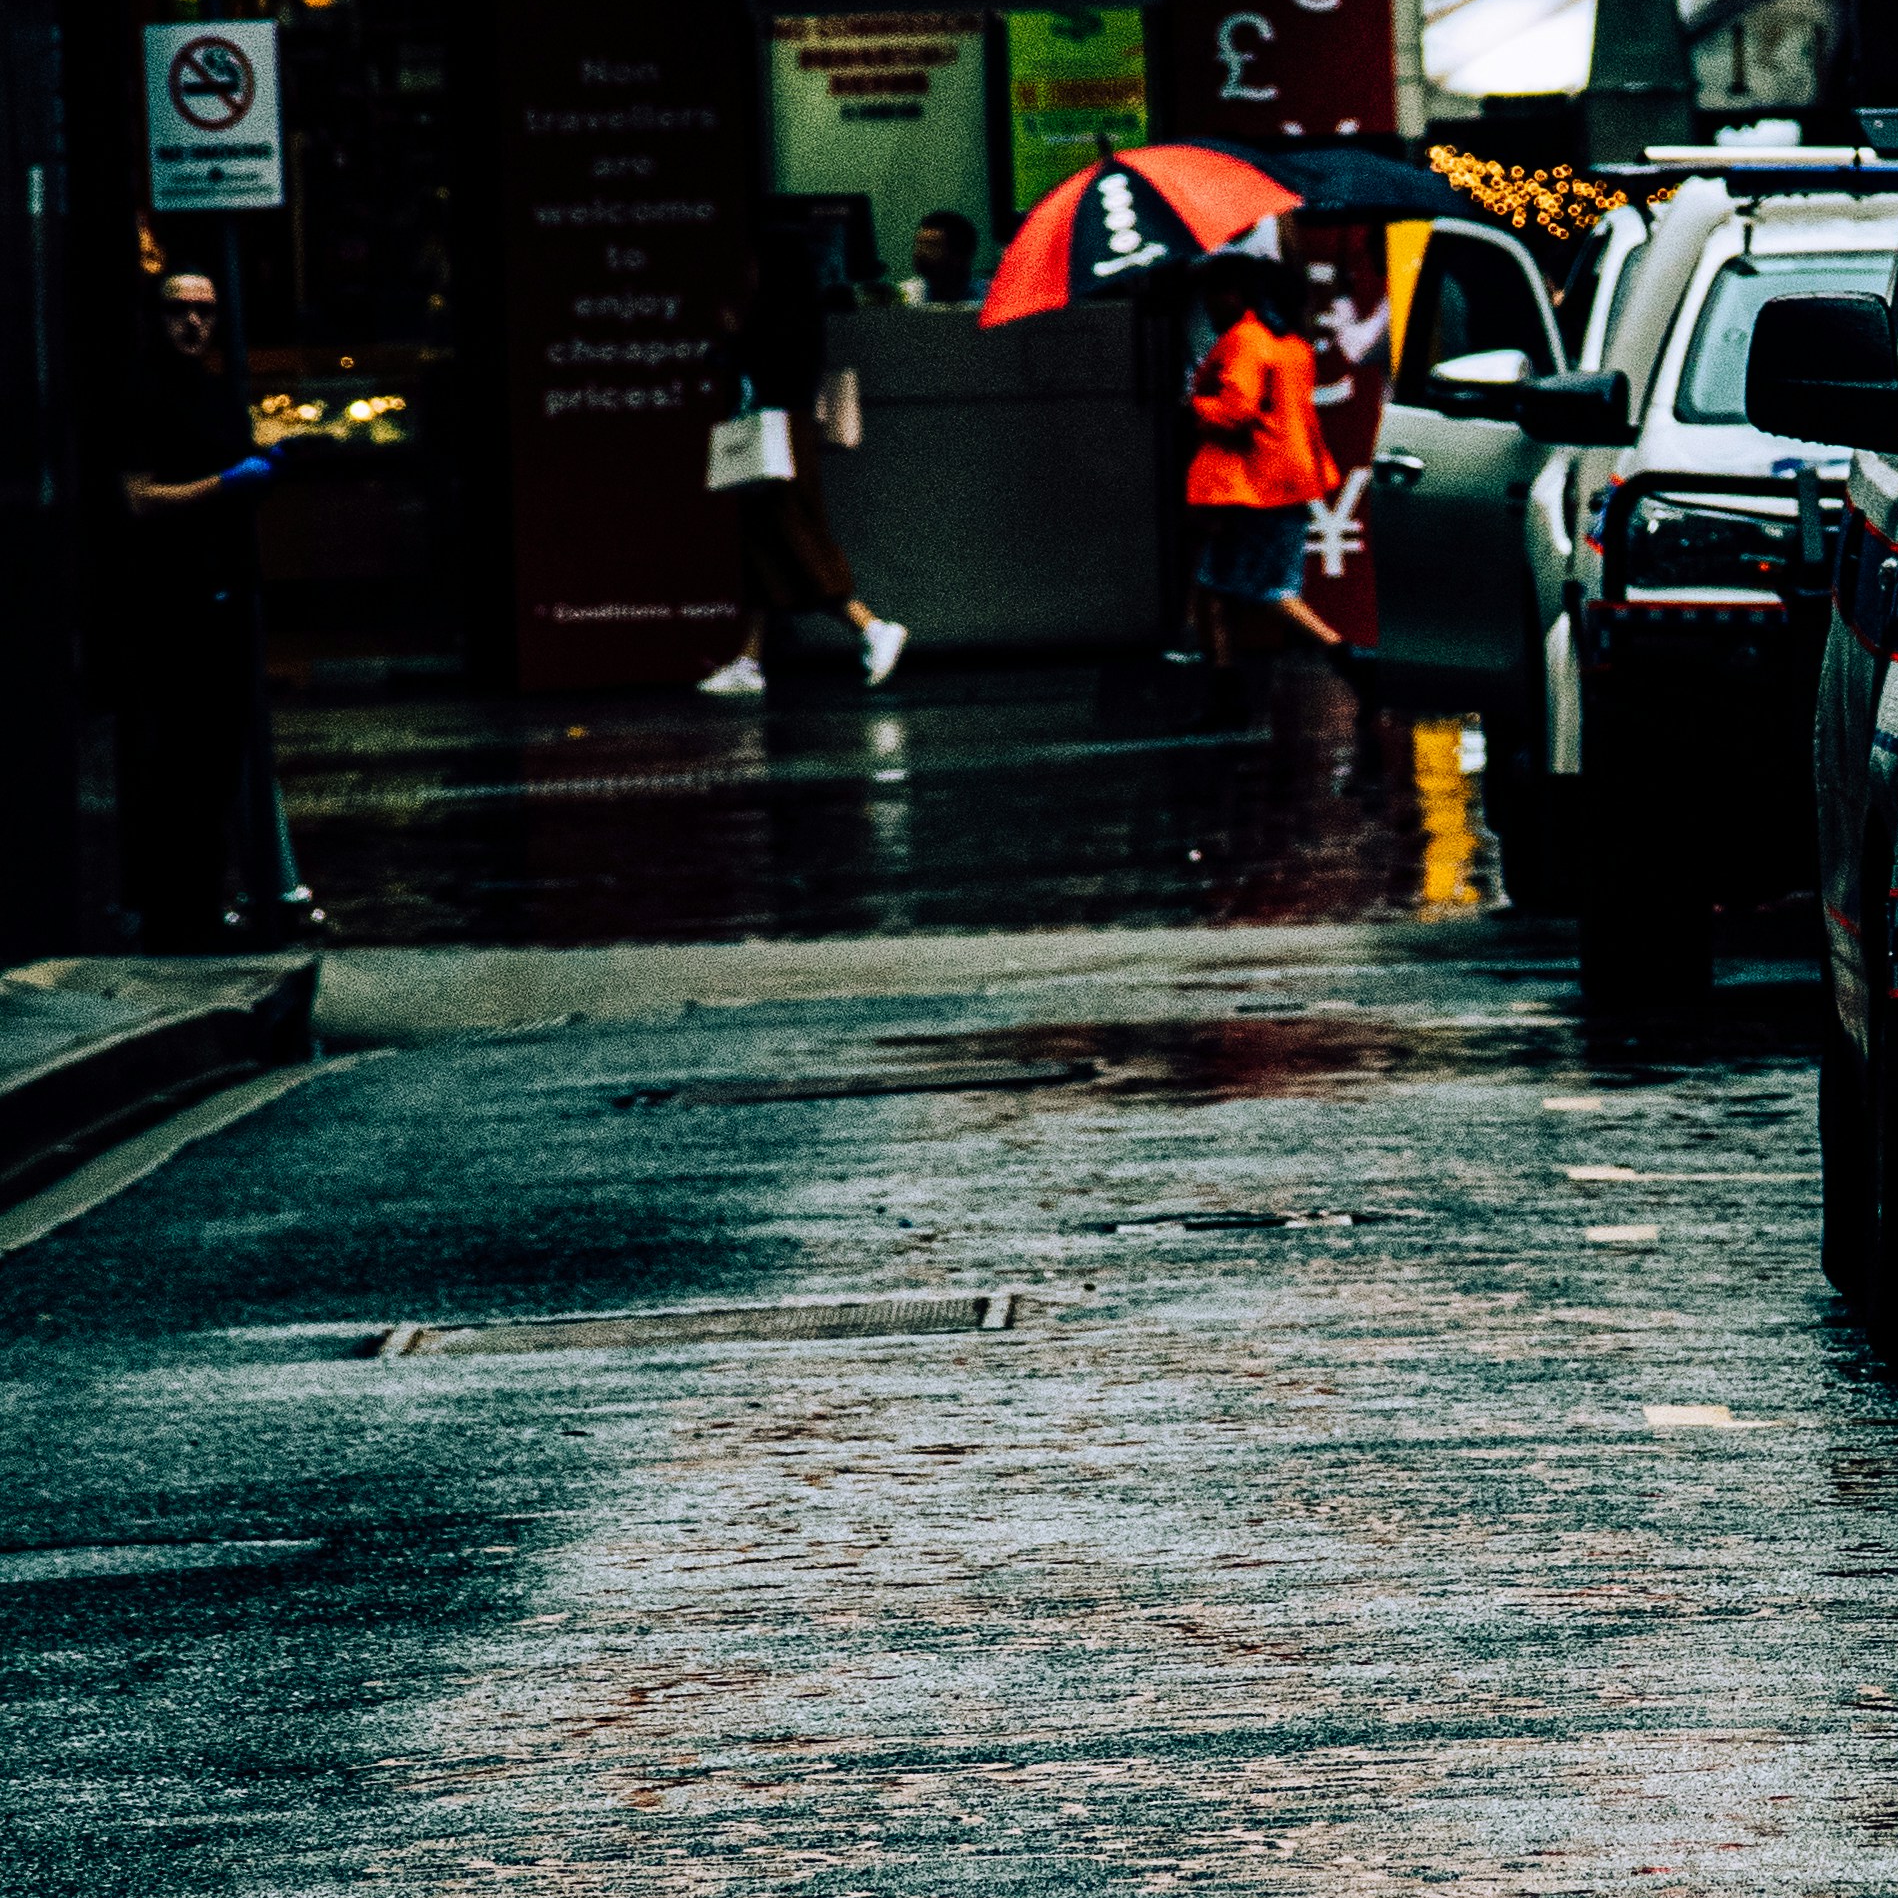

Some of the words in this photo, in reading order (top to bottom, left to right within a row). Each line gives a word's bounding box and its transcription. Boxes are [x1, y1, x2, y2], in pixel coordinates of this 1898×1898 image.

[604, 241, 650, 273] to
[571, 288, 684, 323] enjoy
[544, 335, 712, 369] cheaper
